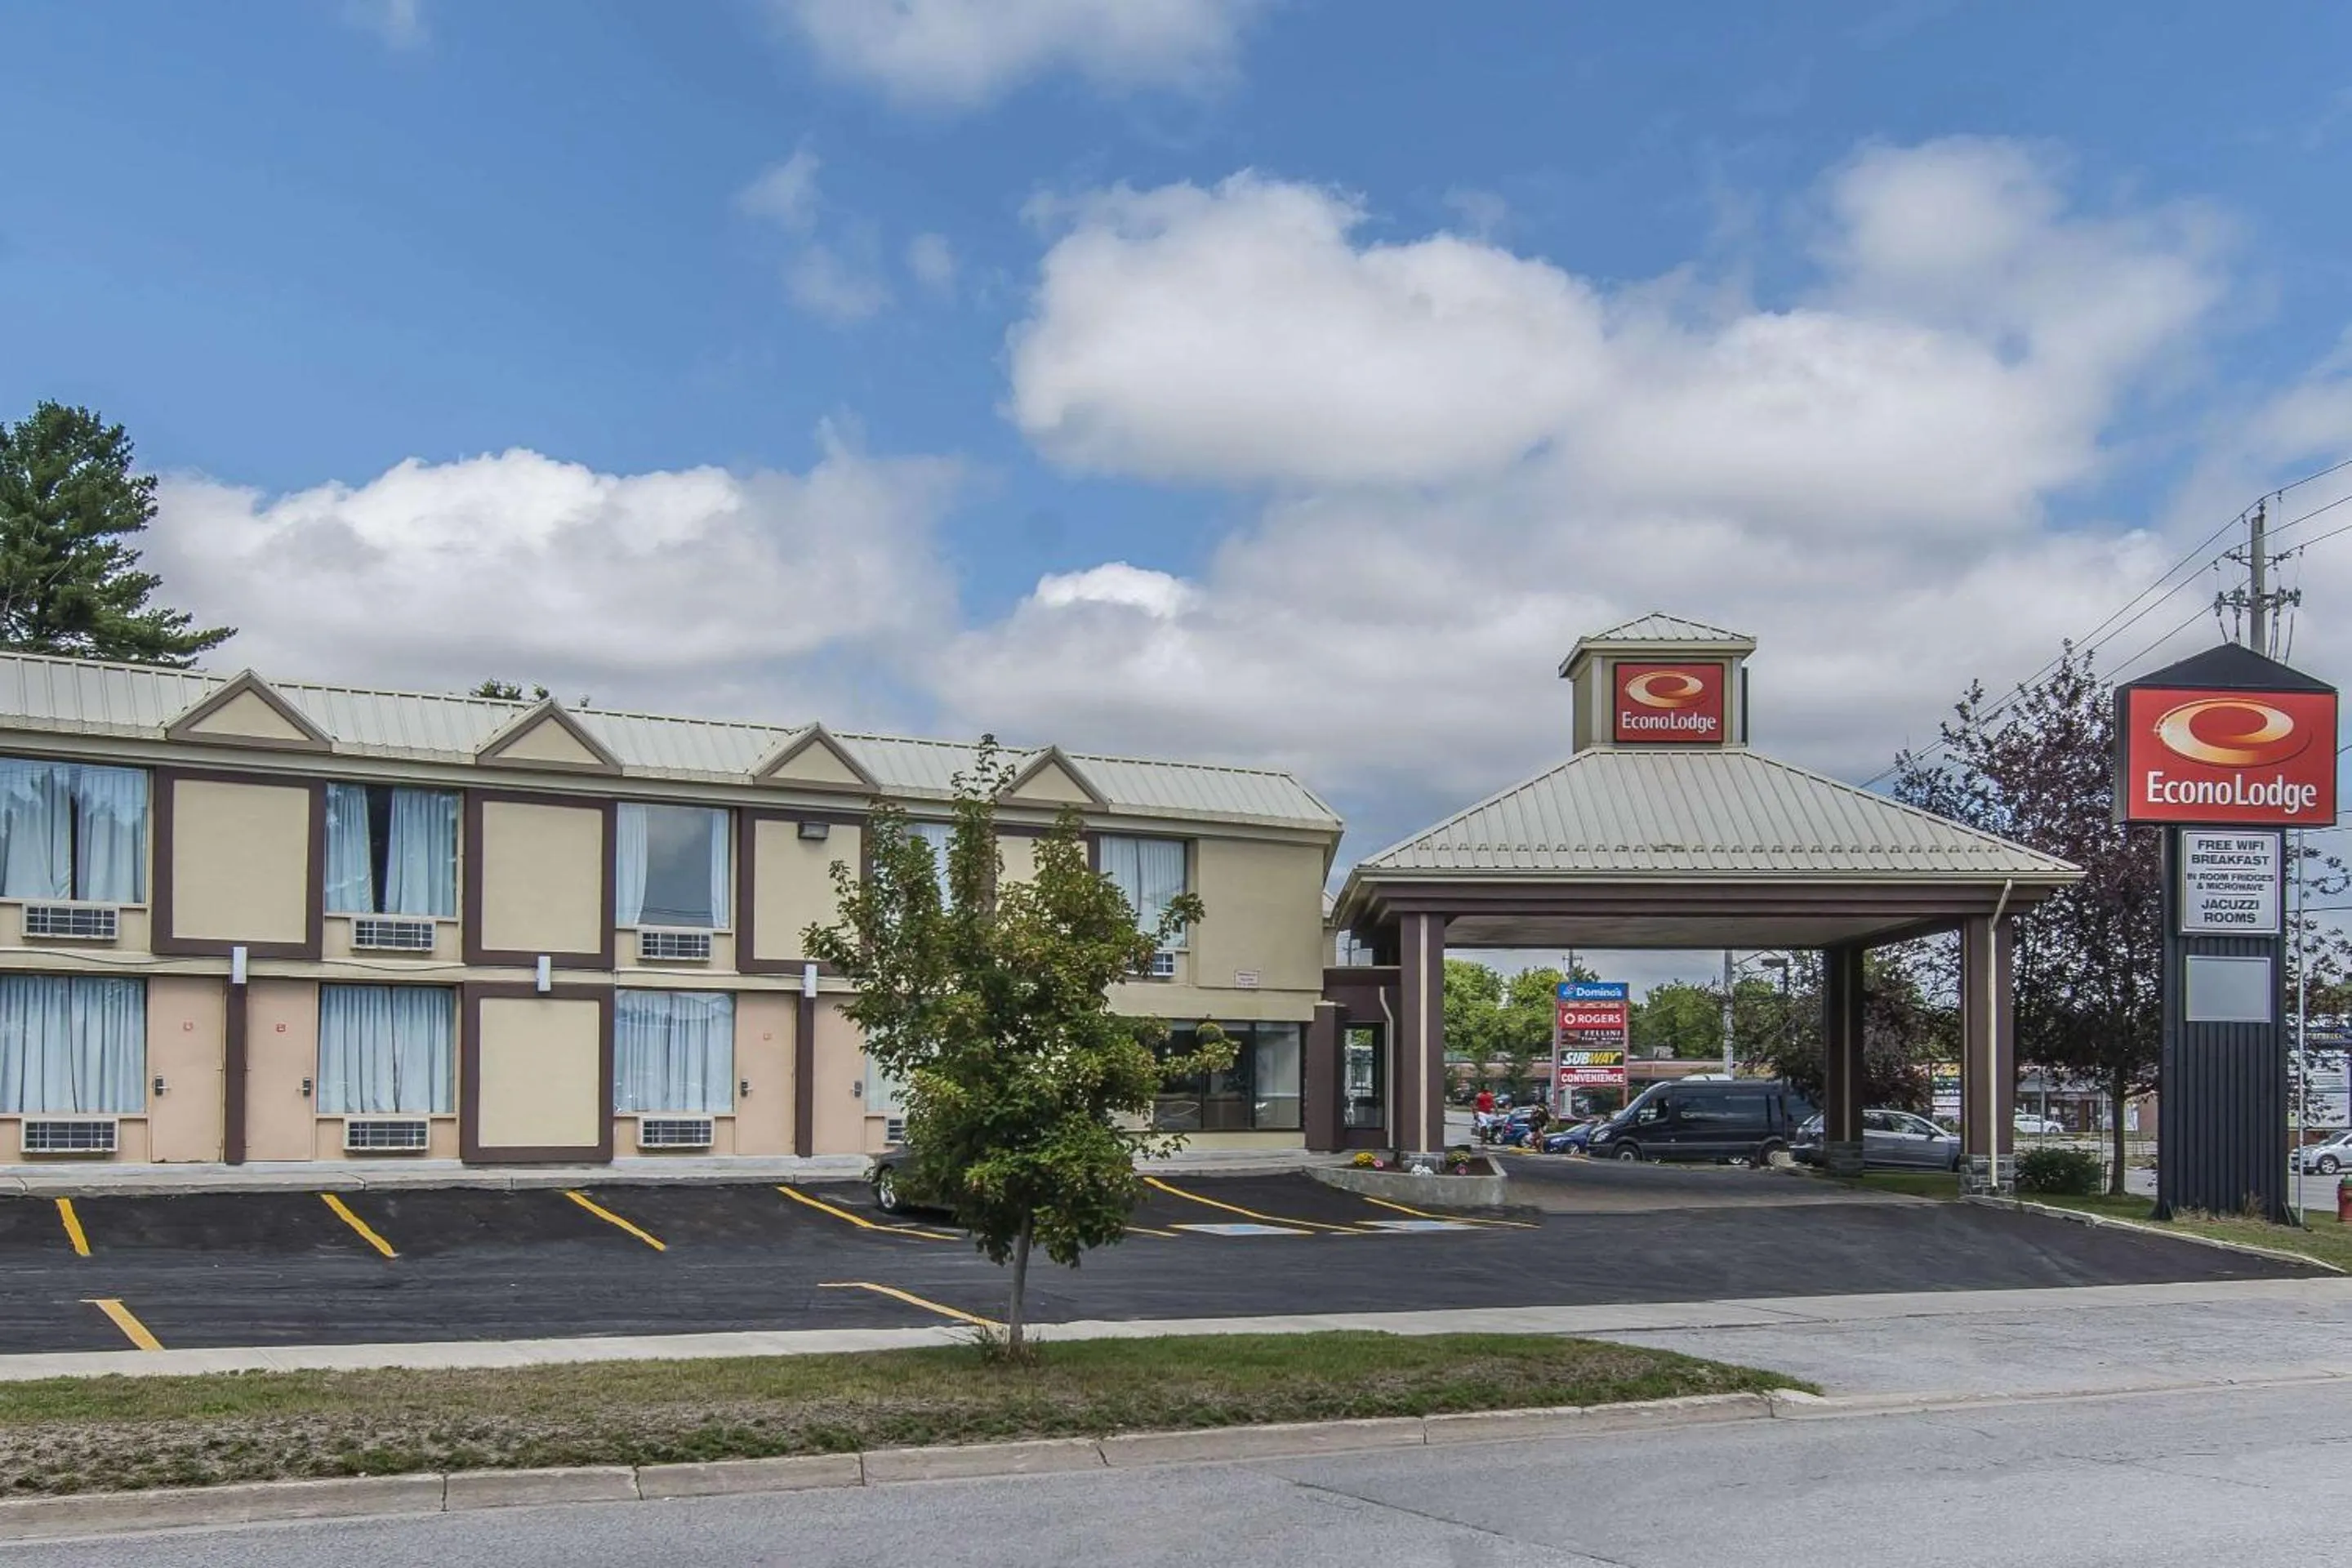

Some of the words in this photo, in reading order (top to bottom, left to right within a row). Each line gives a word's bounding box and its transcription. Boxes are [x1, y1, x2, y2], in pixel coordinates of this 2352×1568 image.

[1622, 711, 1717, 733] EconoLodge
[2147, 771, 2317, 814] EconoLodge
[2198, 840, 2232, 850] FREE
[2236, 840, 2264, 850] WIFI
[2191, 854, 2270, 866] BREAKFAST
[2231, 874, 2274, 882] FRIDGES
[2206, 883, 2264, 891] MICROWAVE
[2201, 899, 2260, 910] JACUZZI
[2204, 912, 2256, 924] ROOMS
[1576, 987, 1622, 997] Domino's
[1577, 1014, 1621, 1023] ROGERS
[1562, 1052, 1622, 1065] SUBWAY
[1561, 1073, 1624, 1083] CONVENIENCE
